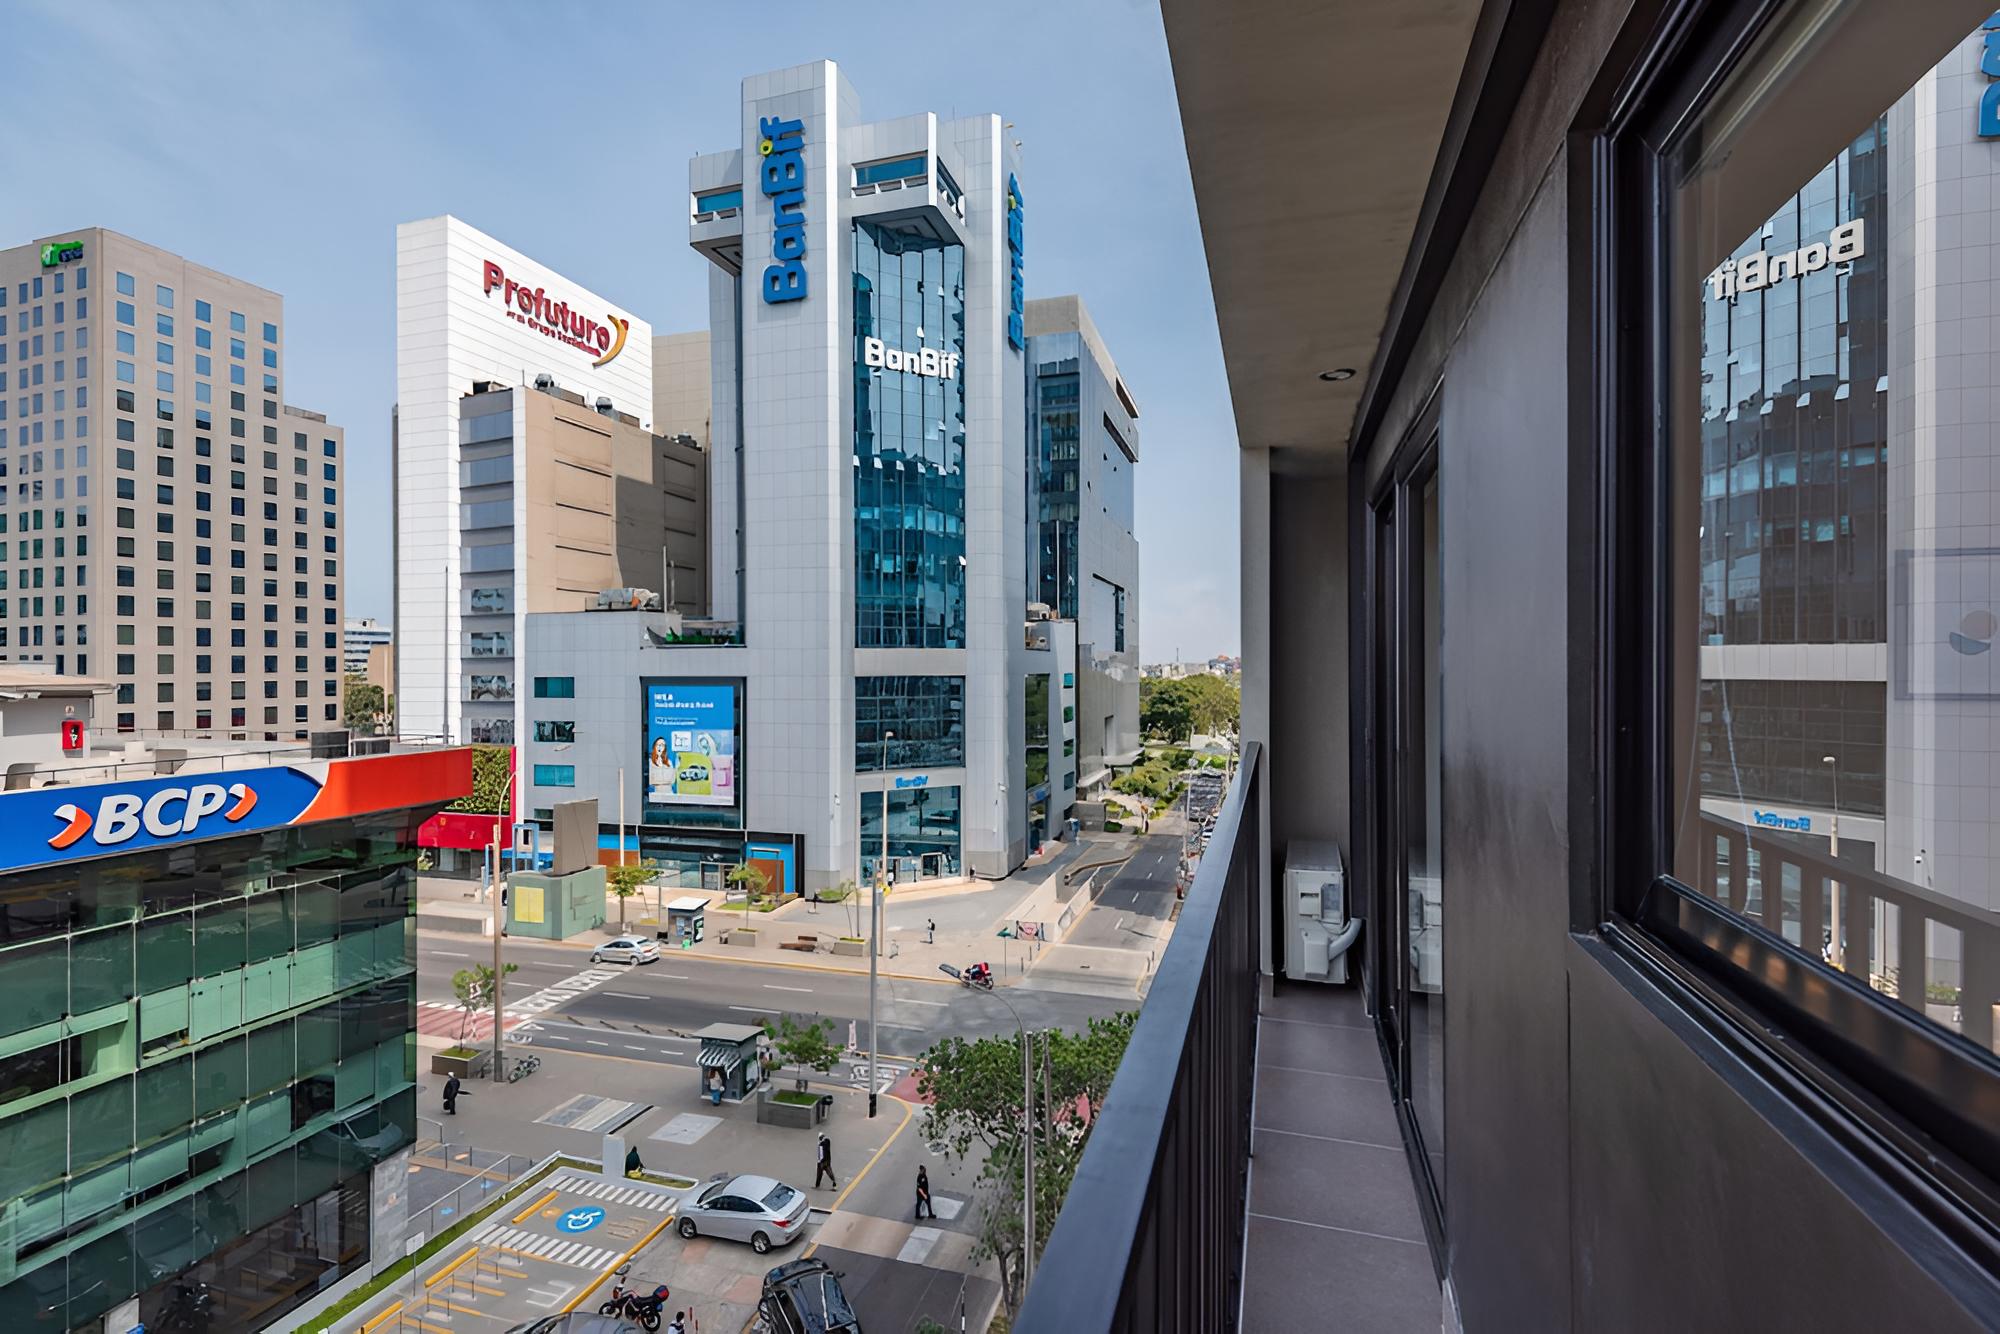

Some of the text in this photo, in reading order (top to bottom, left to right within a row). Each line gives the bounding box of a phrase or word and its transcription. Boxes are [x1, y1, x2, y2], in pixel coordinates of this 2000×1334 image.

[760, 116, 808, 305] BanBif
[484, 259, 610, 351] Profuturo
[865, 336, 959, 380] BanBif
[94, 783, 228, 845] BCP
